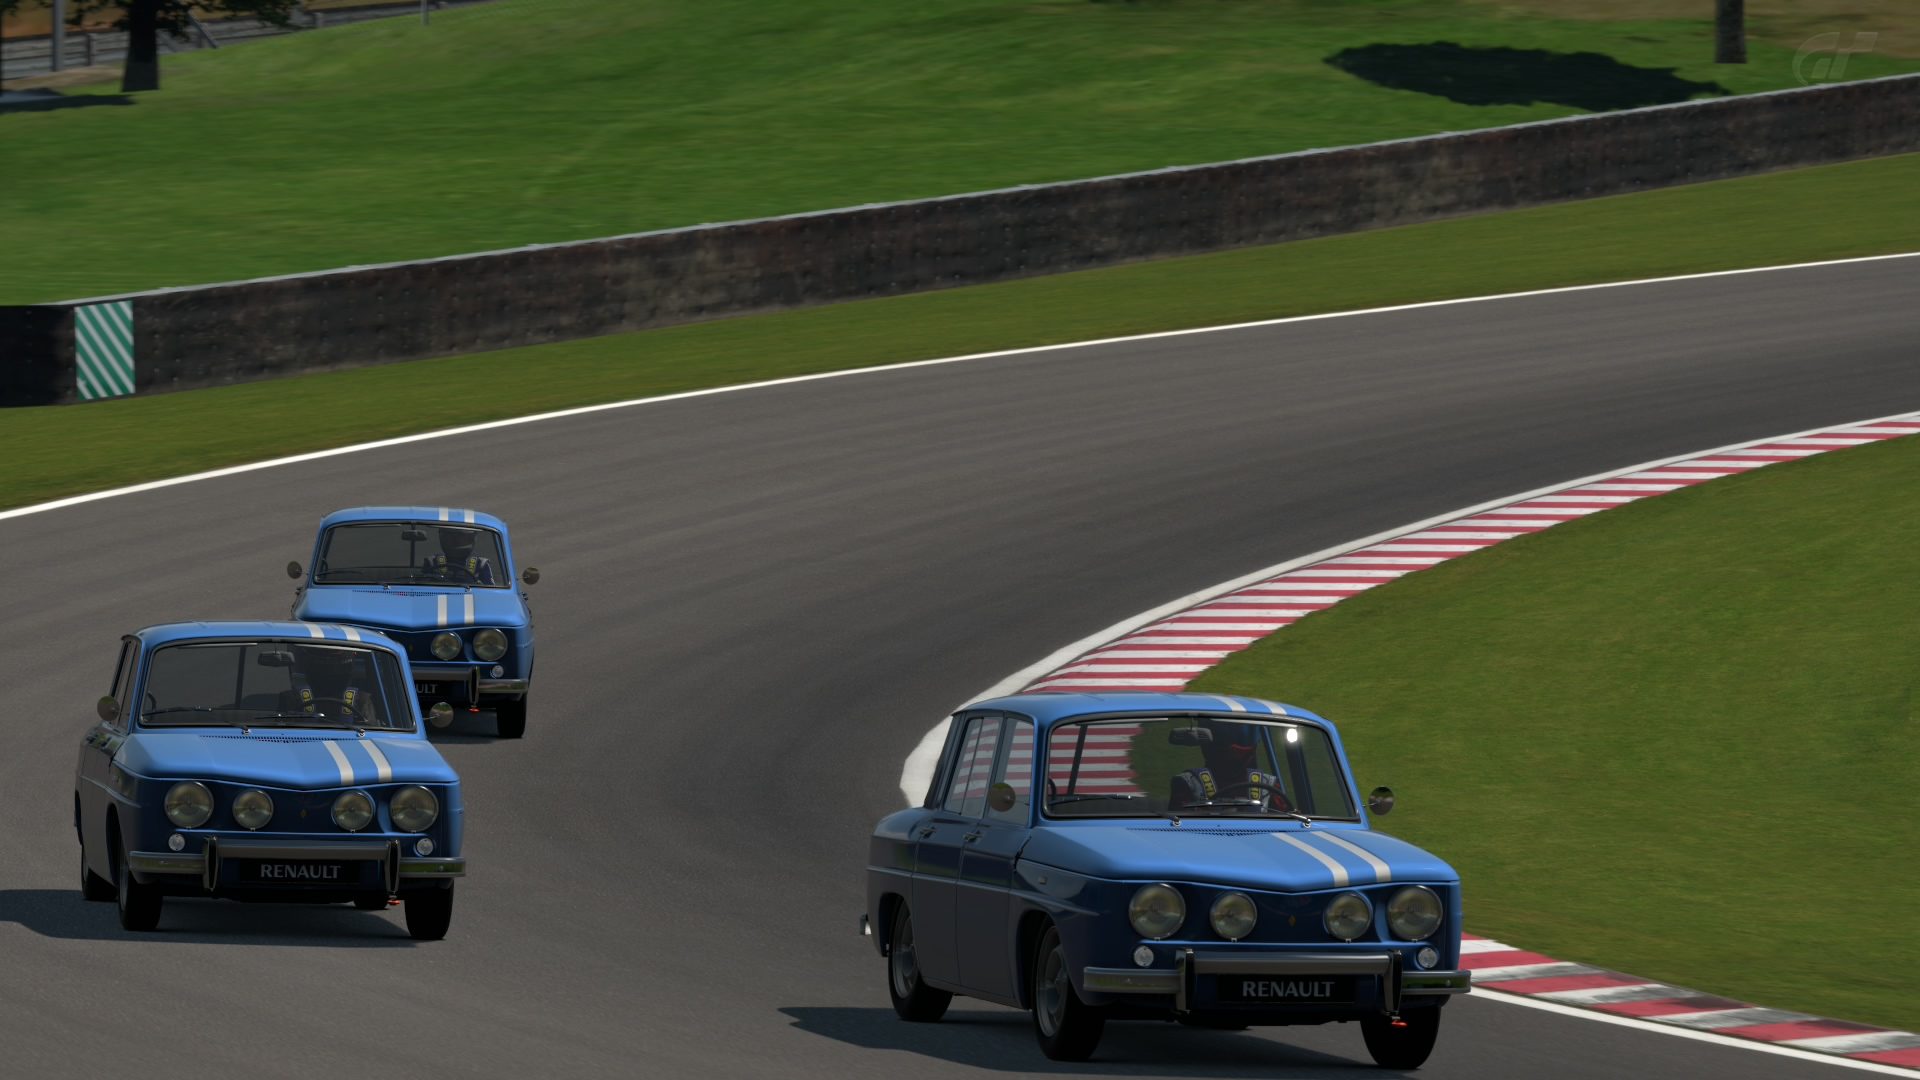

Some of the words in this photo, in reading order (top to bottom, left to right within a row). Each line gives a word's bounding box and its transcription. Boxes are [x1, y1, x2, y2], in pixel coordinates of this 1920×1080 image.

[416, 683, 438, 694] ULT
[260, 864, 341, 879] RENAULT
[1242, 980, 1335, 997] RENAULT
